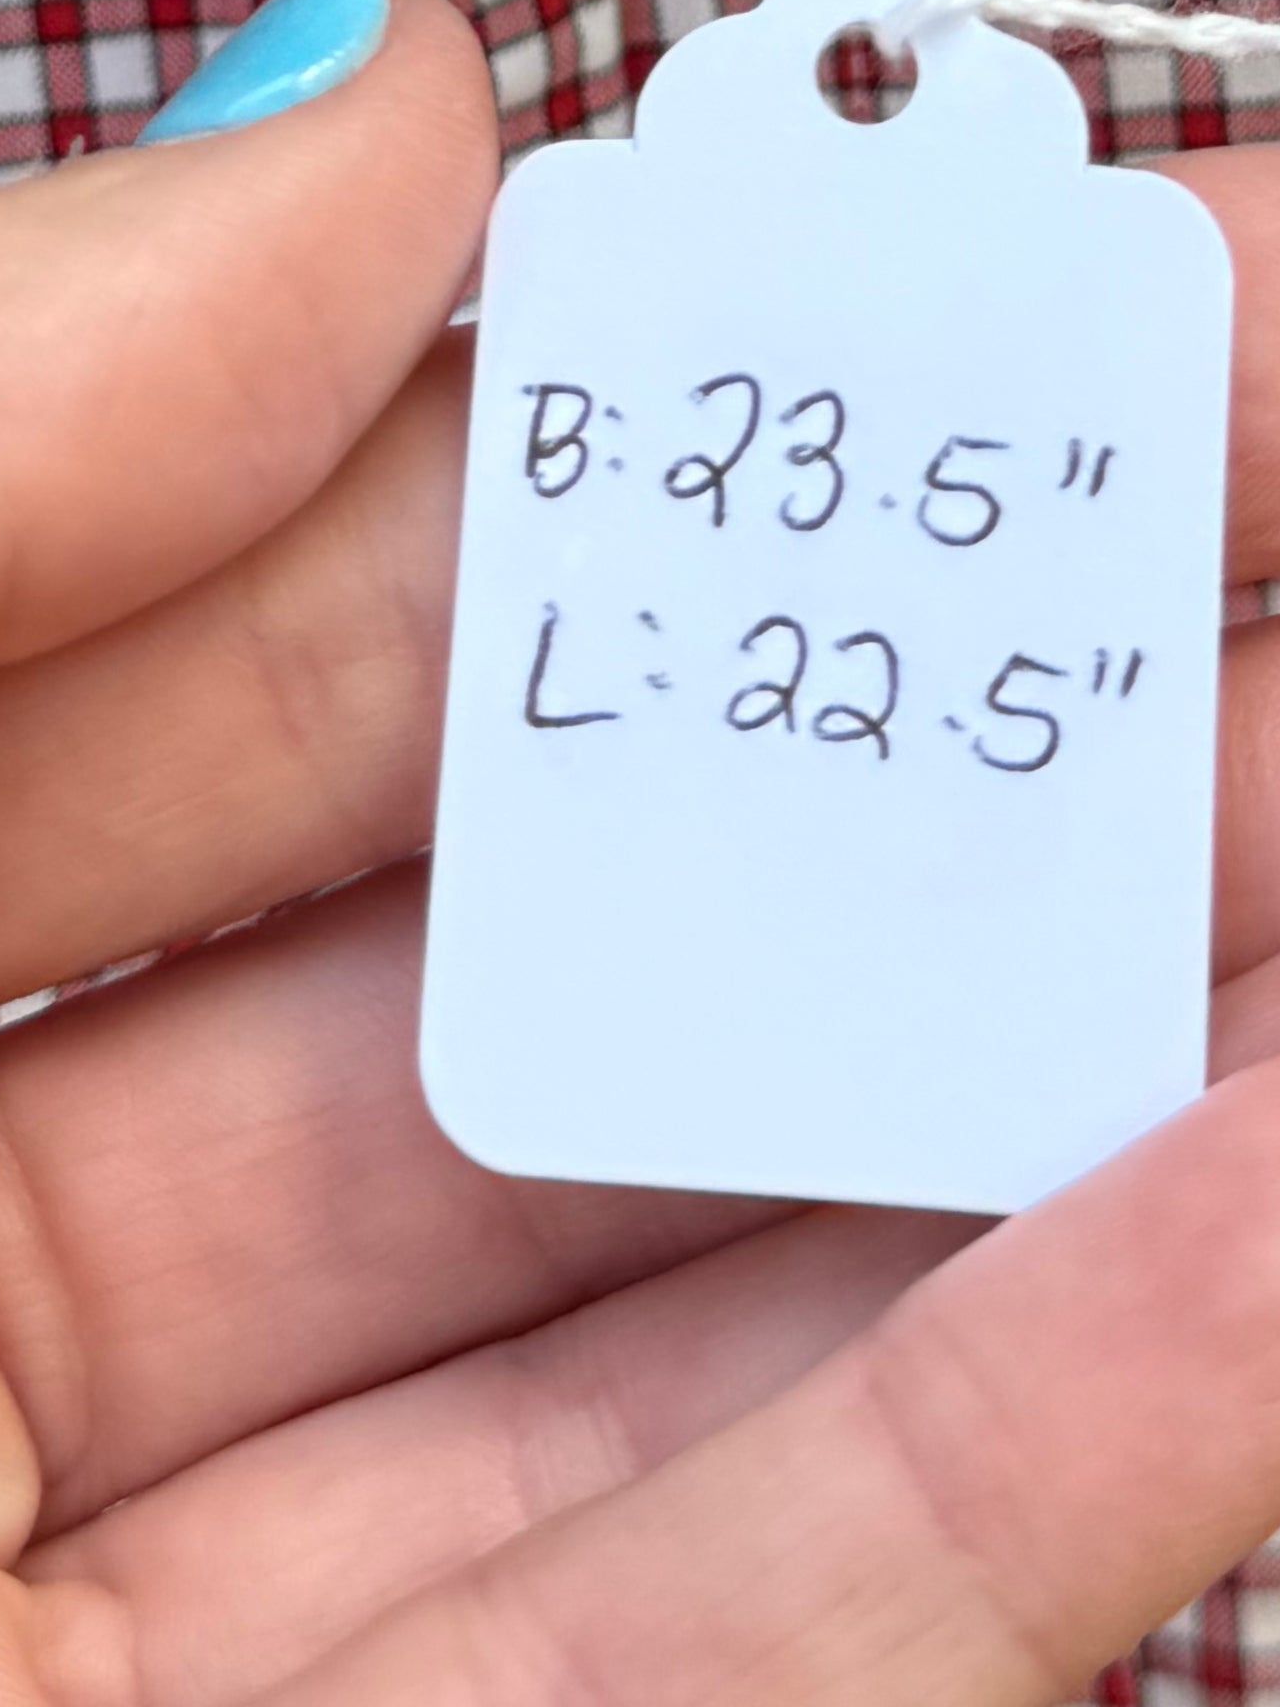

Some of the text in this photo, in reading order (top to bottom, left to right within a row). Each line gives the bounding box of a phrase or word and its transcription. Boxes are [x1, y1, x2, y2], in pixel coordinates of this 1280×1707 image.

[521, 372, 1118, 548] B: 23.5"
[523, 601, 1147, 774] L: 22.5"
